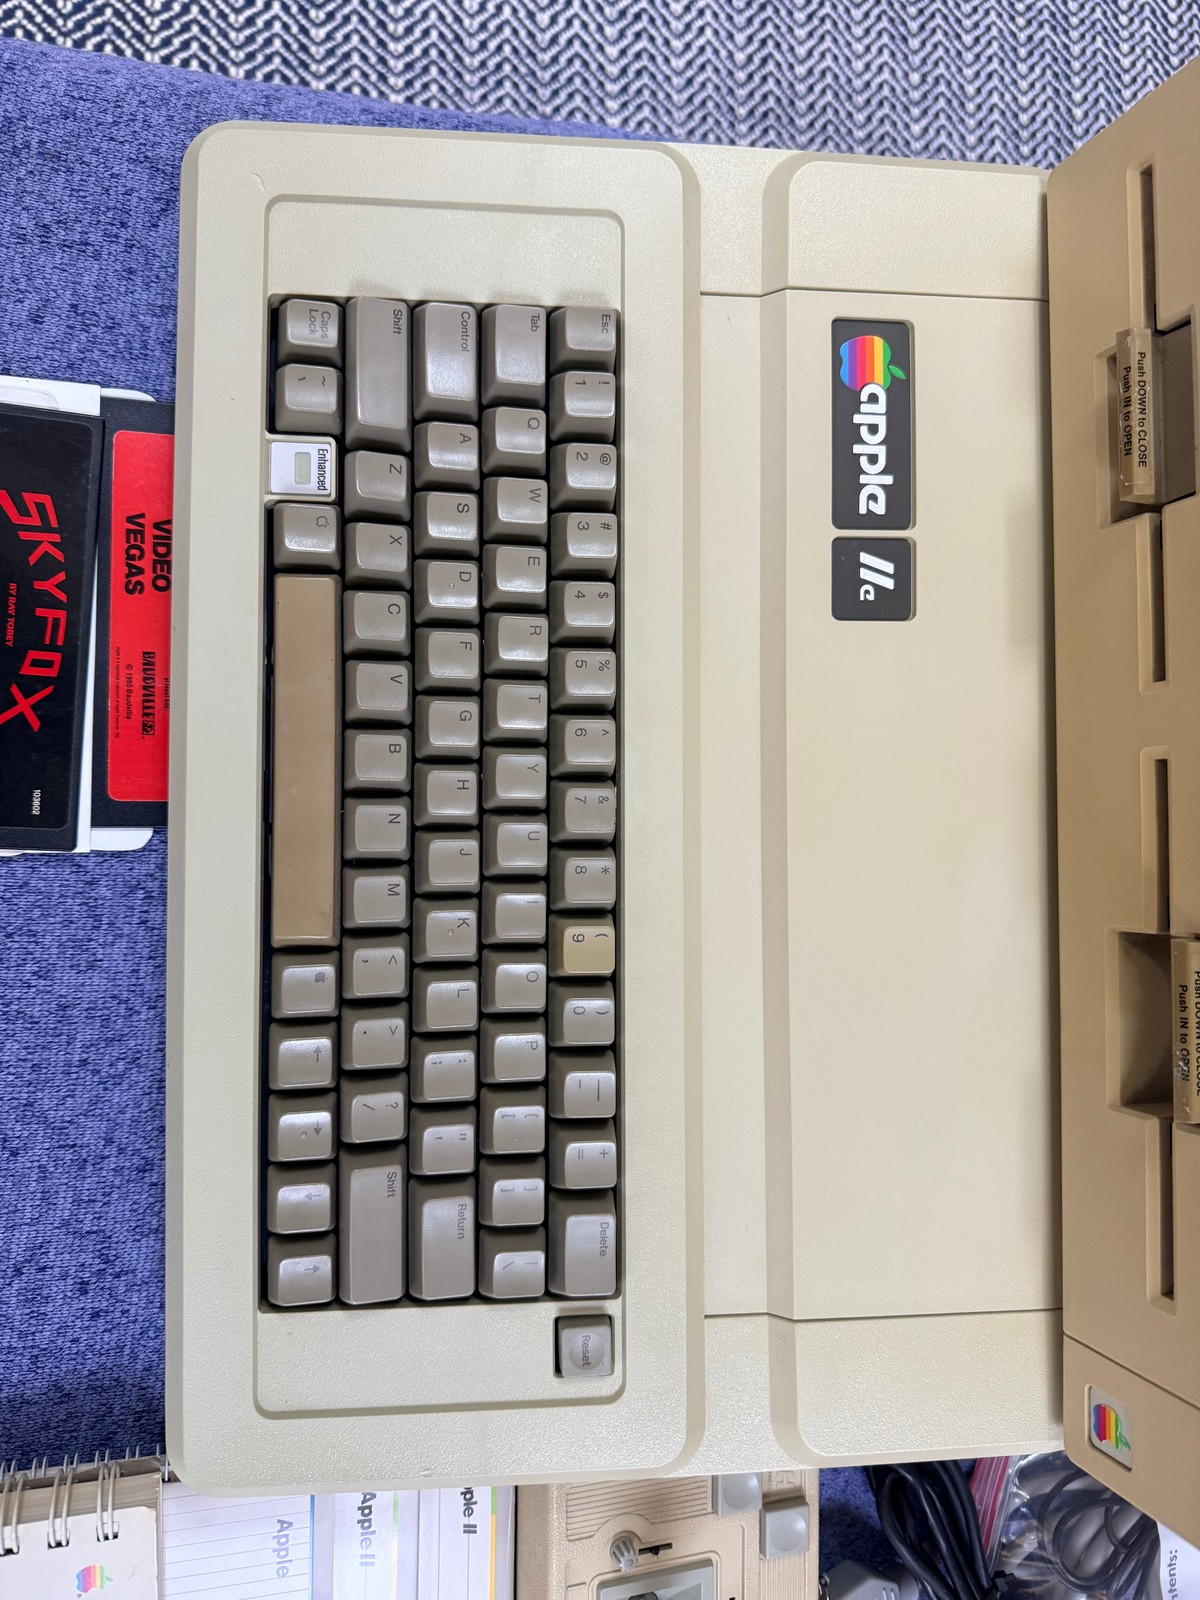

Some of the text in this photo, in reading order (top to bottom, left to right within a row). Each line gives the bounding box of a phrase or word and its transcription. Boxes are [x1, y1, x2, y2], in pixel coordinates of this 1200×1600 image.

[308, 309, 318, 335] Lock
[320, 311, 330, 339] Caps
[393, 309, 402, 334] Shift
[530, 314, 540, 332] Tab
[601, 314, 611, 334] Esc
[460, 311, 471, 352] Control
[321, 376, 327, 387] ~
[1123, 367, 1132, 456] Push IN to OPEN
[1138, 352, 1147, 467] Push DOWN to CLOSE
[527, 417, 540, 430] Q
[460, 433, 471, 444] A
[853, 384, 893, 515] apple
[576, 452, 588, 461] 2
[600, 453, 611, 465] @
[317, 448, 328, 491] Enhanced
[389, 464, 402, 474] Z
[529, 488, 541, 503] W
[457, 502, 469, 514] S
[577, 521, 589, 531] 3
[601, 522, 612, 531] #
[389, 535, 402, 546] X
[125, 513, 145, 595] VEGAS
[152, 519, 172, 592] VIDEO
[528, 556, 540, 566] E
[460, 572, 471, 582] D
[575, 590, 586, 599] 4
[0, 490, 67, 732] SKYFOX
[388, 603, 400, 615] C
[6, 583, 17, 647] BY RAY TOBEY
[530, 626, 541, 636] R
[460, 641, 472, 650] F
[575, 659, 586, 668] 5
[598, 660, 610, 671] %
[390, 674, 402, 684] V
[142, 652, 156, 718] BAUDVILLE
[529, 693, 541, 703] T
[460, 710, 472, 722] G
[575, 728, 586, 737] 6
[389, 744, 401, 754] B
[527, 763, 539, 774] Y
[457, 779, 469, 789] H
[575, 796, 586, 804] 7
[598, 796, 609, 804] &
[388, 814, 400, 824] N
[528, 831, 540, 840] U
[460, 848, 472, 856] J
[575, 865, 587, 875] 8
[388, 884, 400, 896] M
[457, 918, 469, 928] K
[572, 933, 584, 943] 9
[389, 955, 398, 964] <
[526, 971, 538, 982] O
[458, 989, 469, 997] L
[574, 1006, 586, 1015] 0
[389, 1025, 398, 1035] >
[1179, 985, 1190, 1081] Push IN to OPEN
[526, 1041, 538, 1050] P
[363, 1103, 376, 1111] /
[459, 1133, 467, 1141] "
[578, 1149, 584, 1159] =
[599, 1148, 609, 1158] +
[387, 1172, 396, 1198] Shift
[457, 1204, 467, 1239] Return
[599, 1222, 610, 1256] Delete
[502, 1261, 514, 1270] \
[581, 1335, 592, 1367] Reset
[460, 1487, 477, 1518] ple
[357, 1492, 377, 1550] Apple
[272, 1519, 293, 1578] Apple
